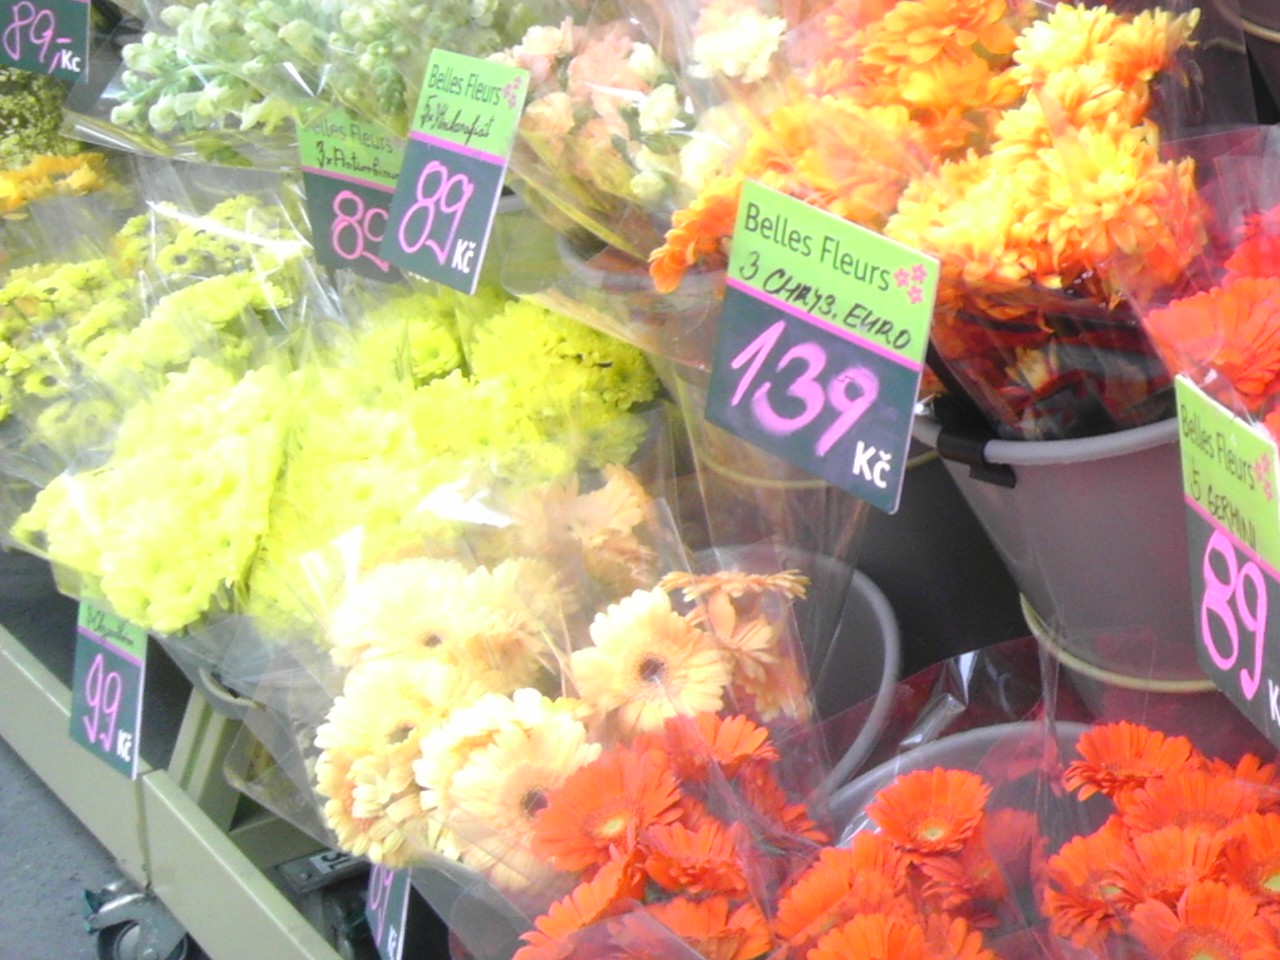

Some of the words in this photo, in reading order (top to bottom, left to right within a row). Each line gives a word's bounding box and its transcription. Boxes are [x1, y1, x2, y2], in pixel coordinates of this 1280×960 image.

[428, 64, 464, 95] Belles
[465, 73, 502, 106] Fleurs
[350, 123, 393, 153] Fleurs
[399, 160, 474, 265] 89
[452, 239, 476, 273] Kč
[745, 203, 812, 258] Belles
[820, 236, 891, 292] Fleurs
[740, 251, 760, 280] 3
[843, 304, 912, 350] EURO
[731, 319, 880, 457] 139
[852, 440, 892, 489] Kč
[1180, 404, 1215, 458] Belles
[1217, 432, 1255, 490] Fleurs
[1190, 470, 1201, 501] 5
[1202, 529, 1267, 701] 89
[82, 653, 121, 752] 99
[116, 730, 133, 762] Kč
